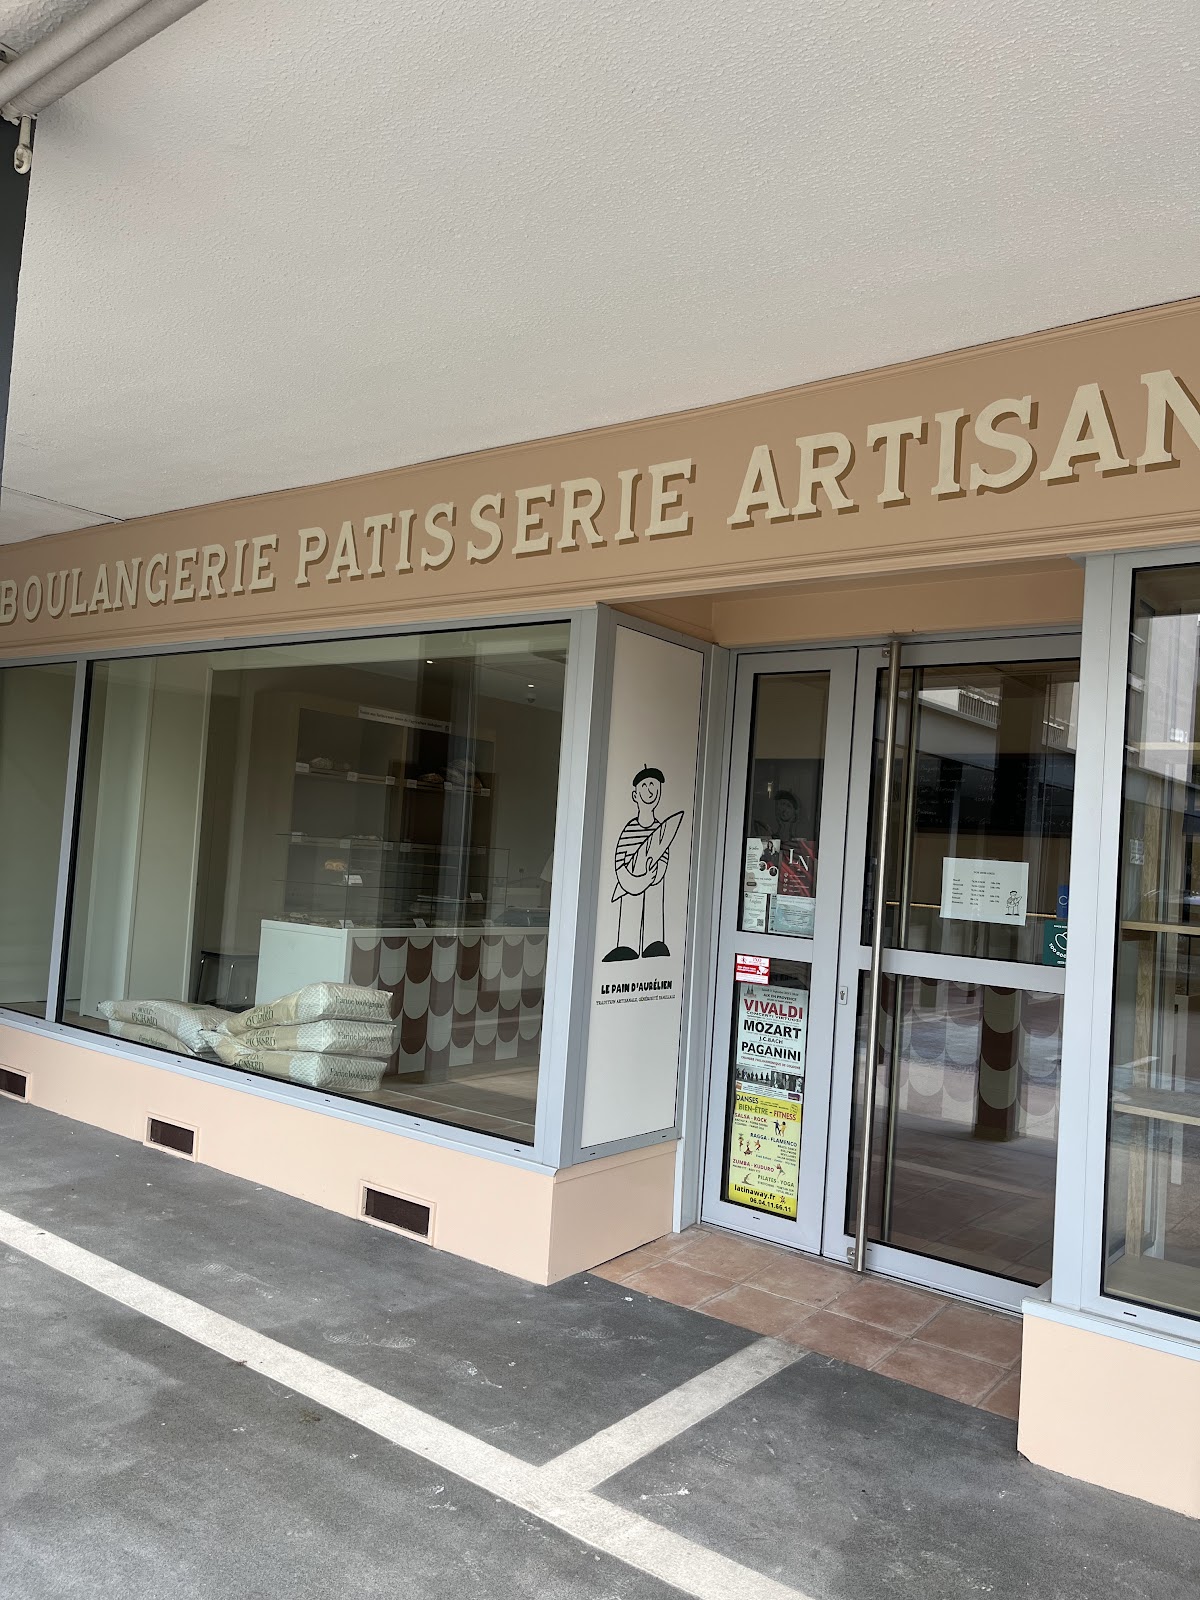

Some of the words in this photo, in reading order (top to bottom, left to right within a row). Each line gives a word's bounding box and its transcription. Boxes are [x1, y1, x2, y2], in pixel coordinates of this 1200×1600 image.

[0, 533, 277, 625] BOULANGERIE
[295, 458, 696, 587] PATISSERIE
[726, 369, 1200, 528] ARTISAN
[601, 984, 610, 995] LE
[611, 983, 630, 994] PAIN
[631, 978, 673, 993] D'AURÉLIEN
[744, 998, 803, 1020] VIVALDI
[744, 1020, 802, 1039] MOZART
[742, 1041, 801, 1062] PAGANINI
[736, 1094, 759, 1105] DANSES
[734, 1112, 750, 1120] SALSA
[773, 1110, 797, 1121] FITNESS
[770, 1137, 798, 1147] FLAMENCO
[732, 1158, 751, 1167] ZUMBA
[753, 1163, 775, 1172] KUDURO
[757, 1174, 777, 1183] PILATES
[780, 1180, 795, 1188] YOGA
[734, 1184, 776, 1200] latinaway.fr
